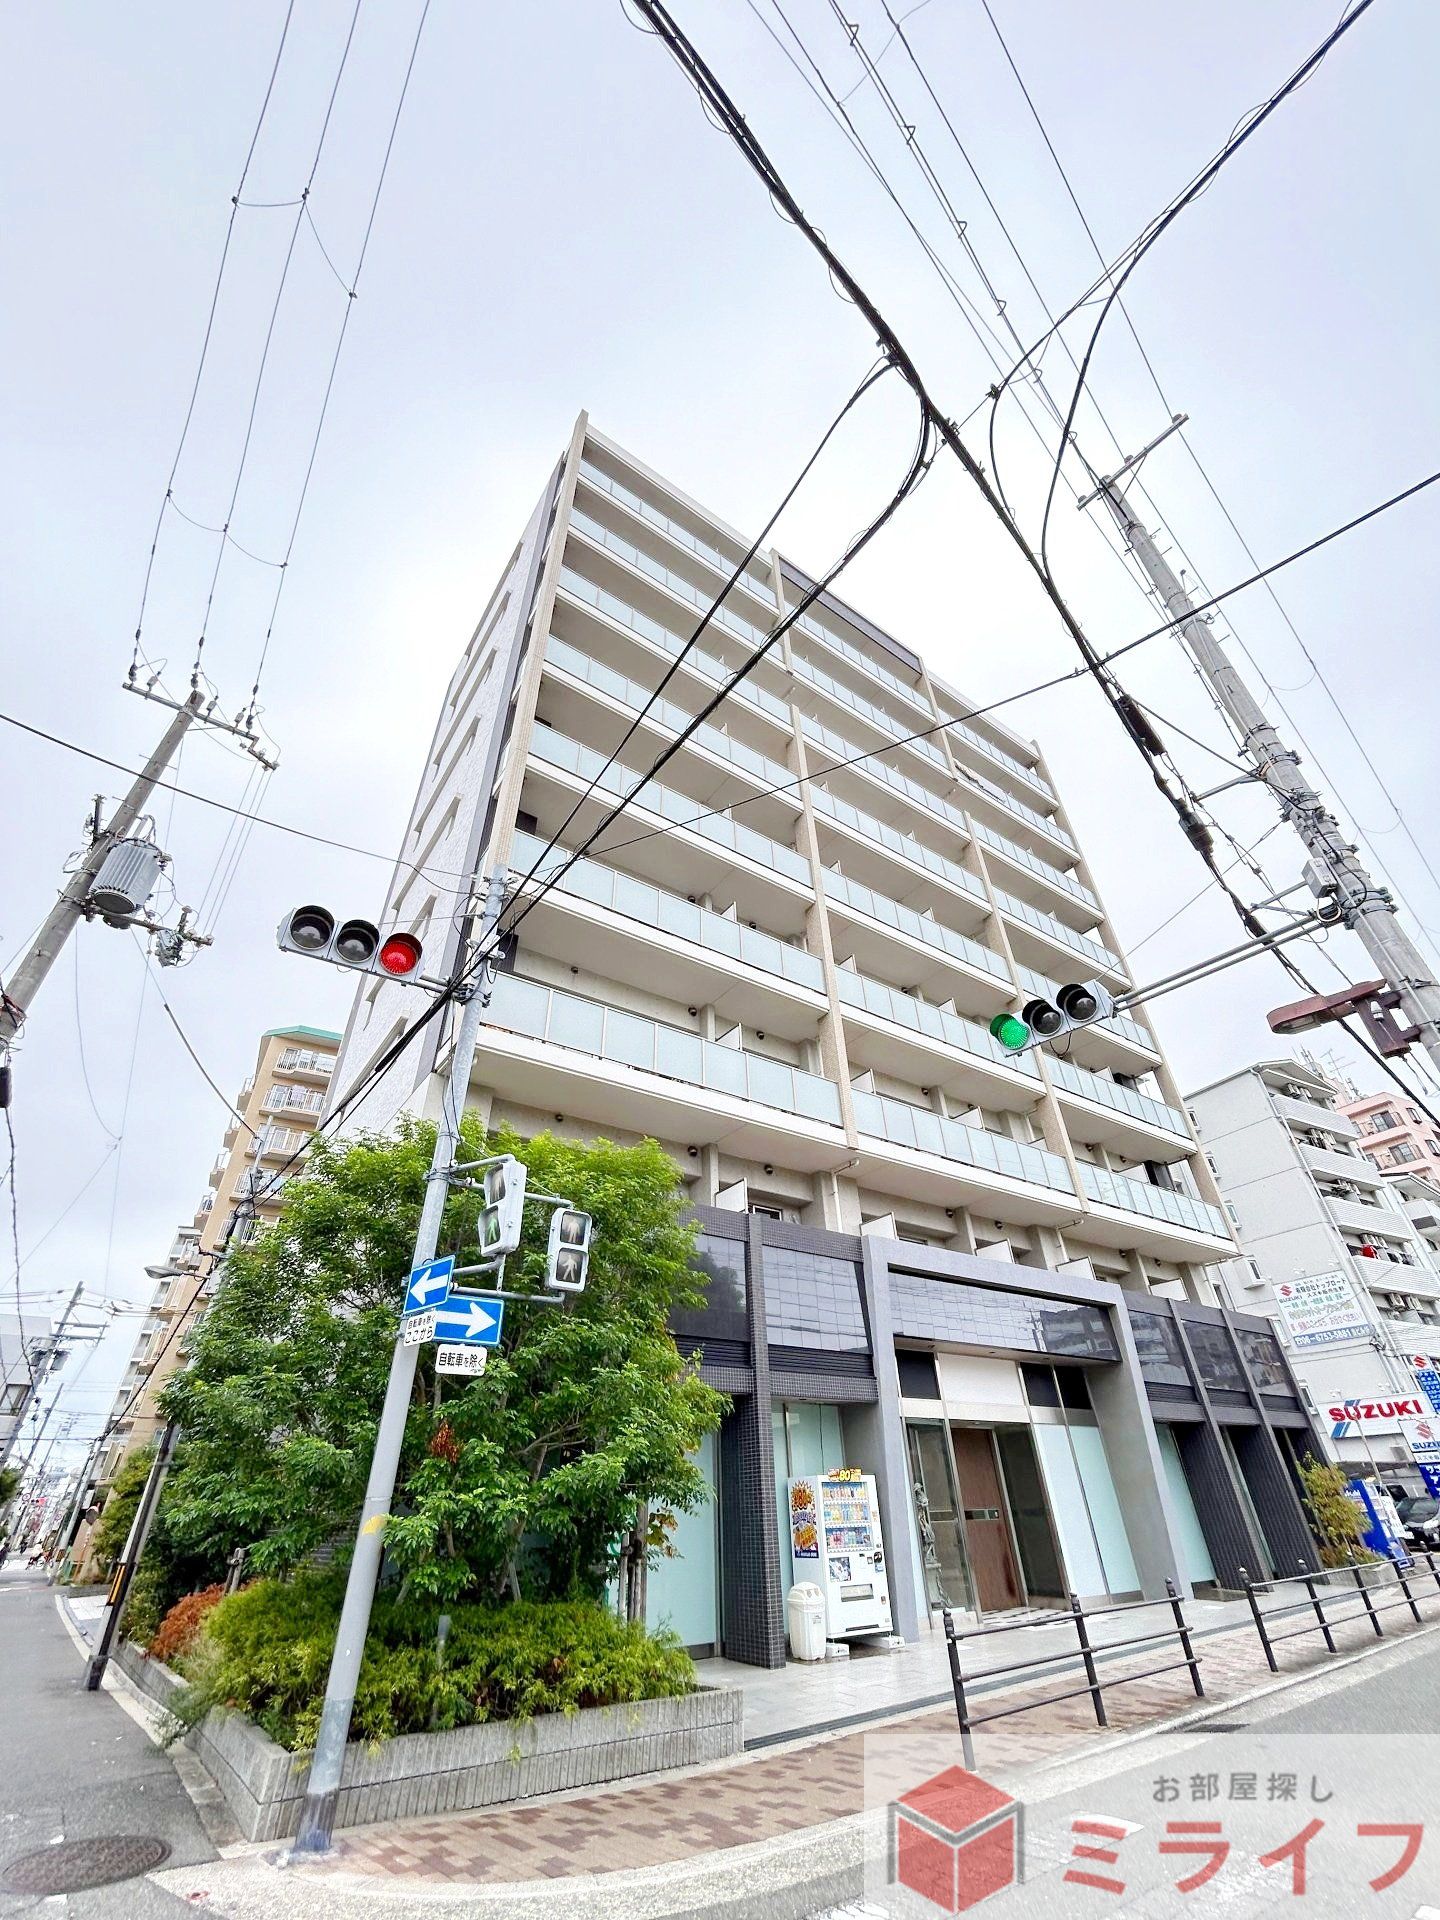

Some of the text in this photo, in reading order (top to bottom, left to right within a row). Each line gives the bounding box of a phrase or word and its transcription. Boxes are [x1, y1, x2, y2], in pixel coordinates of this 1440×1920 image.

[1279, 1295, 1302, 1303] SUZUKI
[408, 1315, 435, 1329] 自転車を除く
[405, 1326, 433, 1343] ここから
[439, 1352, 484, 1368] 自転車を除く
[1329, 1400, 1423, 1421] SUZUKI
